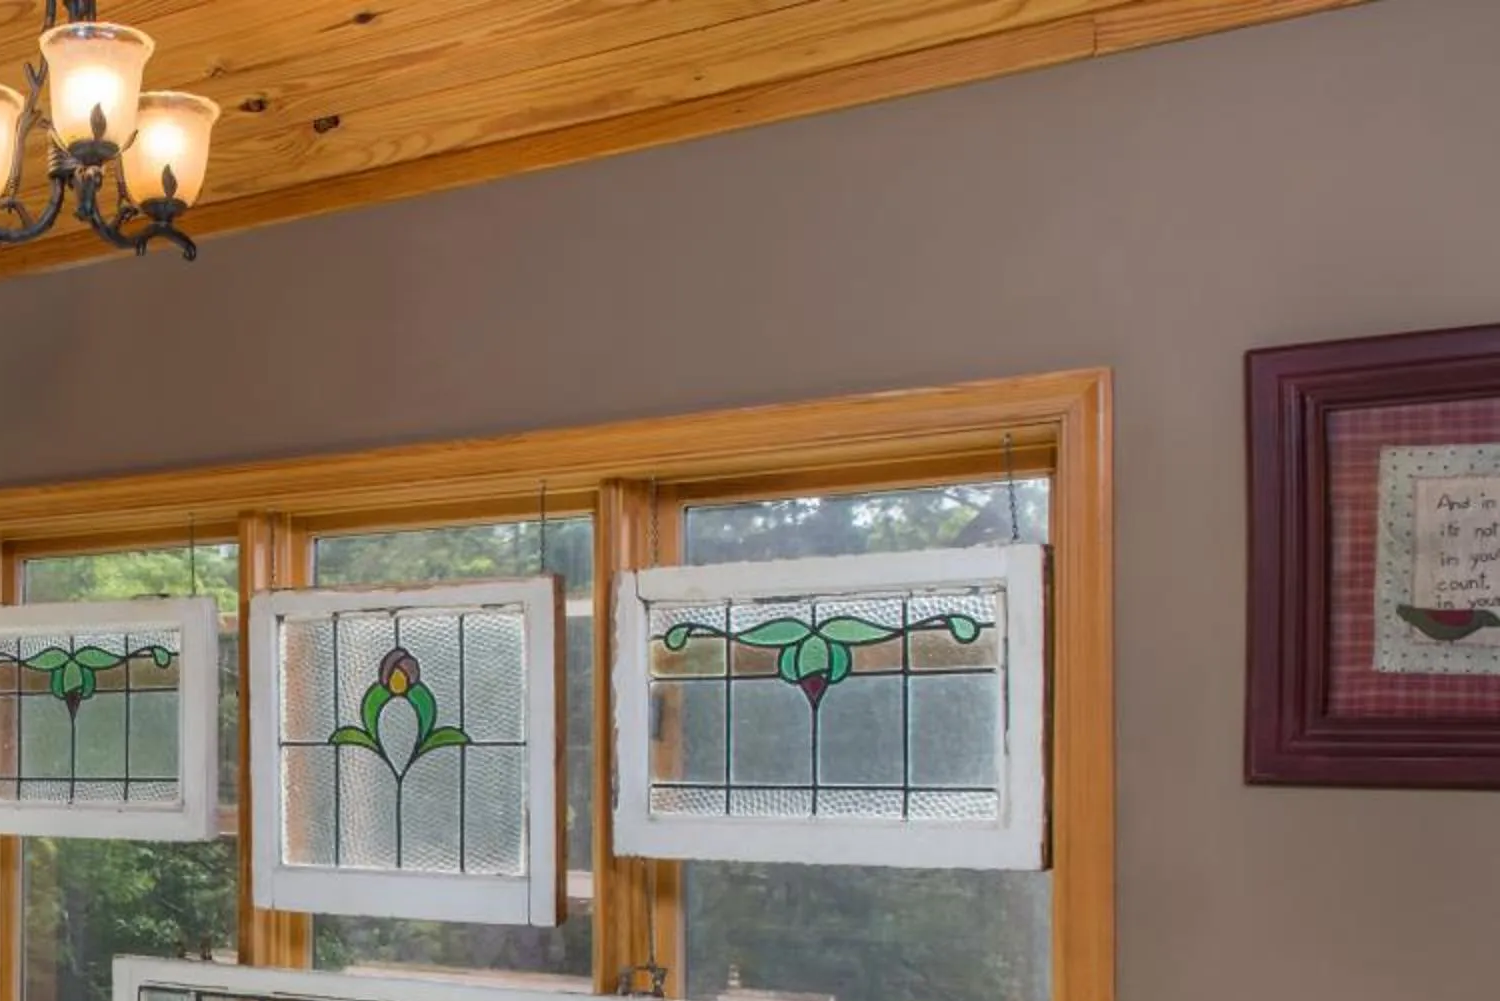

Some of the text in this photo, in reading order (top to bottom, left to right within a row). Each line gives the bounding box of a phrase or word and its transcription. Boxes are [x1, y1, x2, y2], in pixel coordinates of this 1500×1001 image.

[1436, 491, 1497, 511] And in
[1474, 522, 1500, 540] not
[1440, 551, 1460, 568] in
[1437, 572, 1491, 592] count.
[1435, 594, 1456, 609] in
